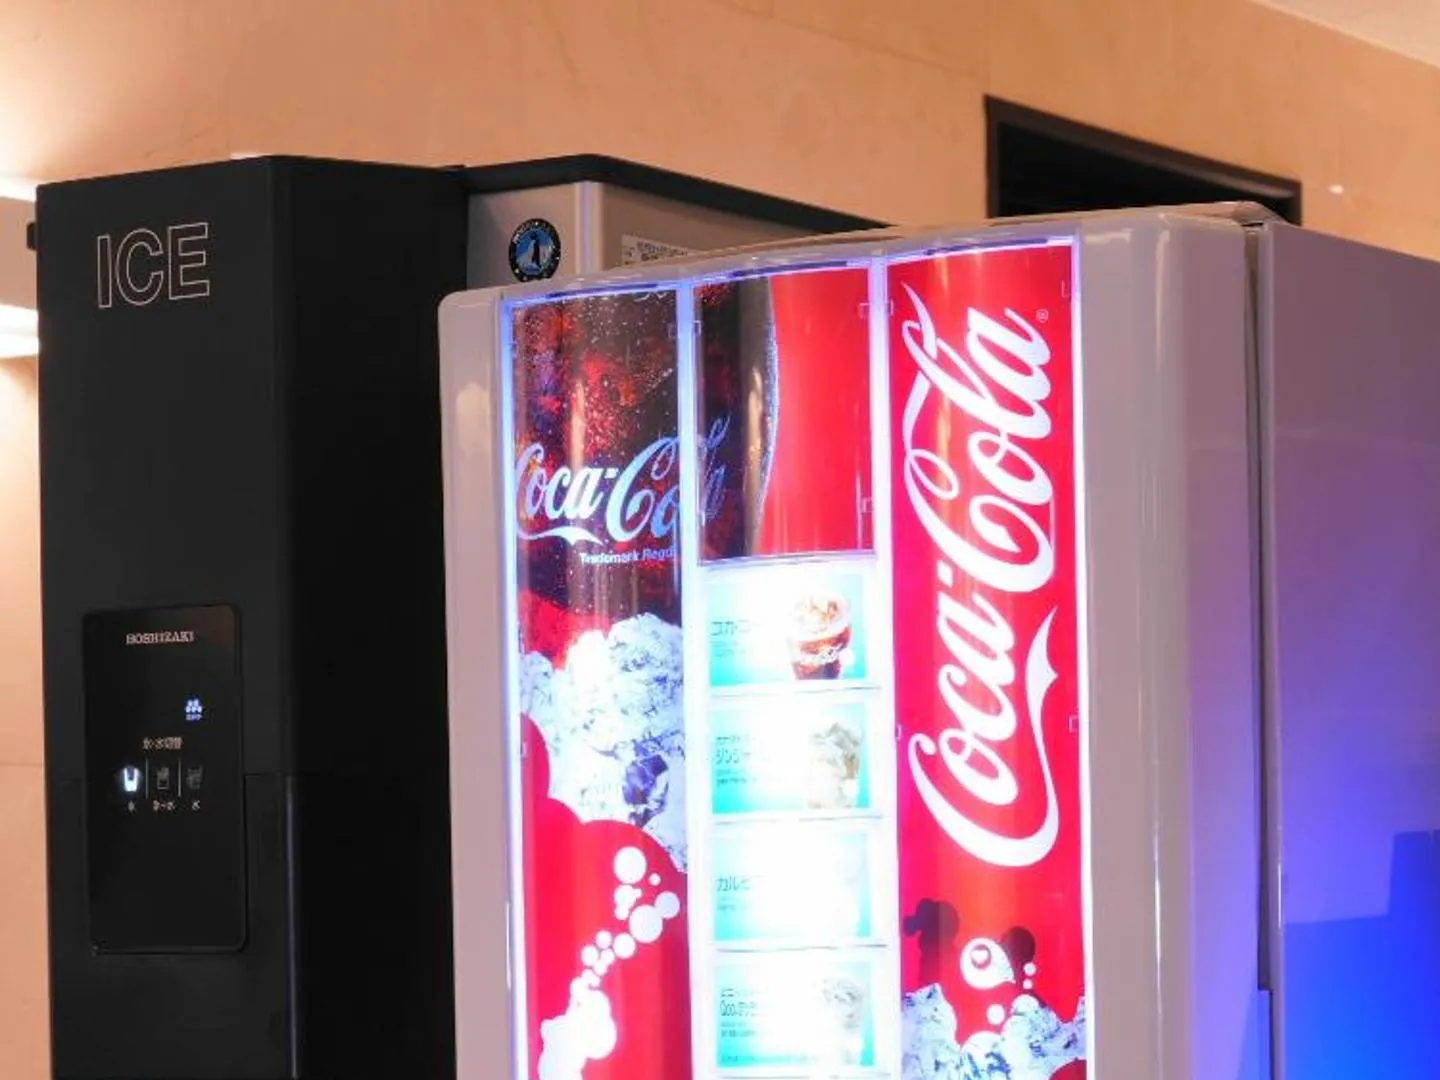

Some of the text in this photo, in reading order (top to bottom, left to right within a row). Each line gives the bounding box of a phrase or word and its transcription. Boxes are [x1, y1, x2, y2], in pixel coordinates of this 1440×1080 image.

[97, 222, 210, 308] ICE
[901, 280, 1060, 868] Coca-Cola
[125, 631, 194, 645] HOSHIZAKI
